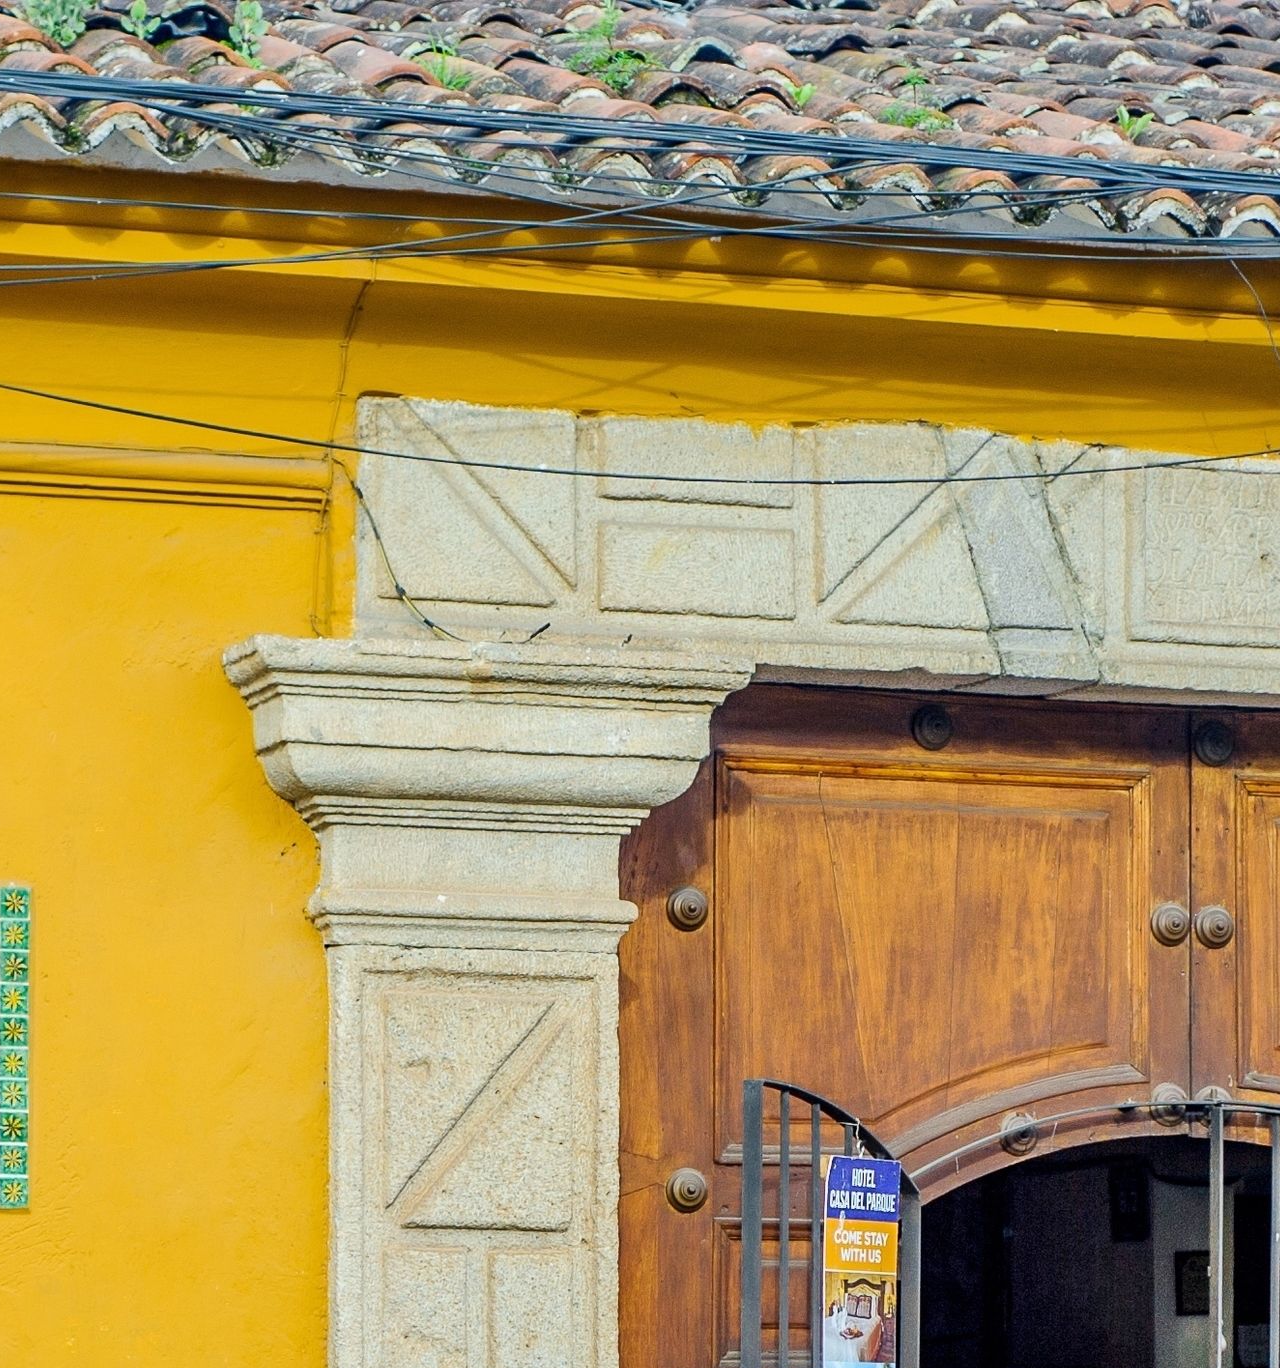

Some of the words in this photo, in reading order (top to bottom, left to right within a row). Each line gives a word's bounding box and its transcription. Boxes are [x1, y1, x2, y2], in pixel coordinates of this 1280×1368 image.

[852, 1168, 876, 1188] HOTEL
[830, 1190, 849, 1209] CASA
[851, 1191, 865, 1210] DEL
[866, 1192, 896, 1212] PARQUE
[834, 1229, 862, 1245] COME
[864, 1232, 888, 1247] STAY
[841, 1247, 867, 1262] WITH
[870, 1250, 882, 1263] US
